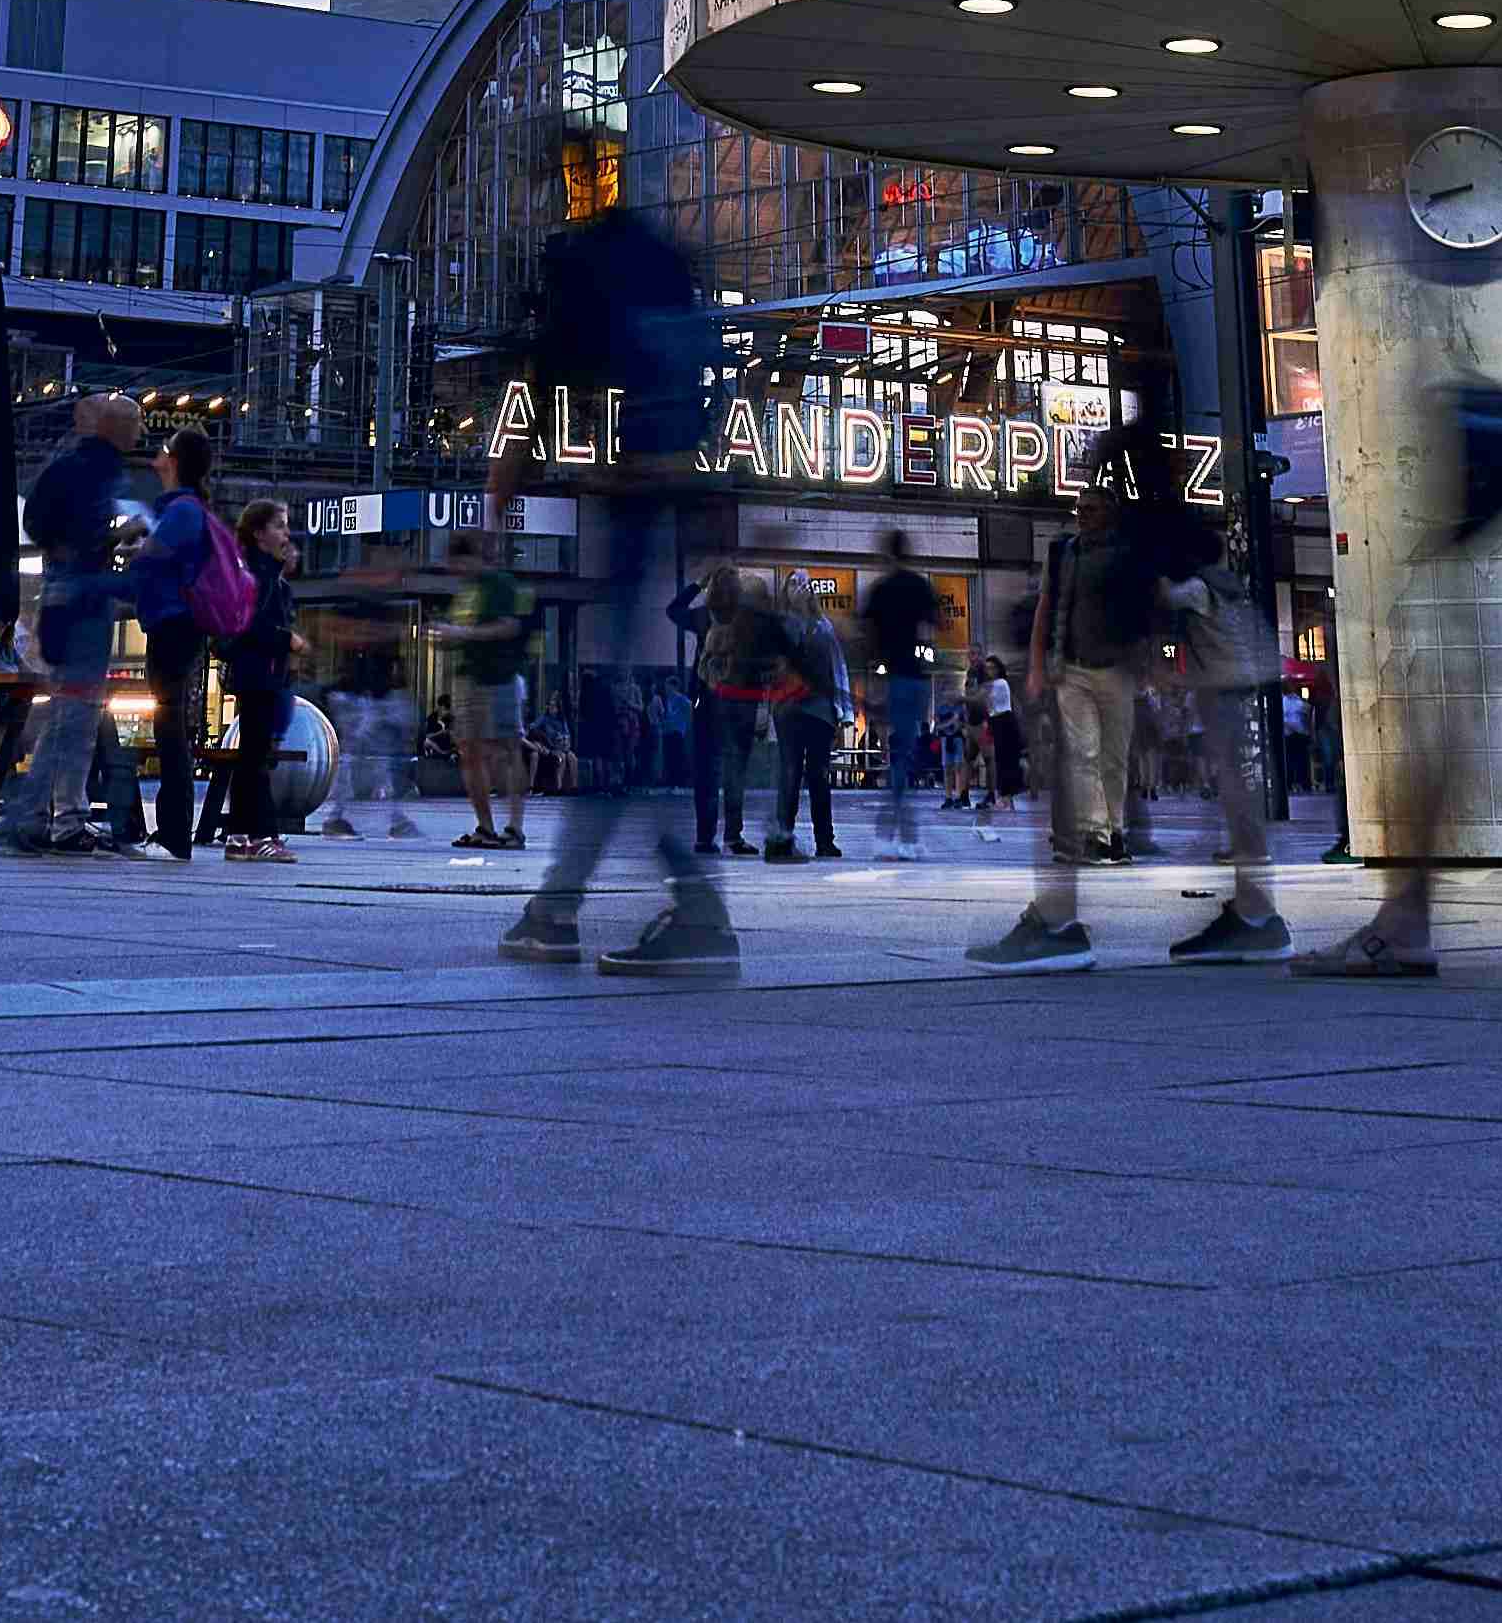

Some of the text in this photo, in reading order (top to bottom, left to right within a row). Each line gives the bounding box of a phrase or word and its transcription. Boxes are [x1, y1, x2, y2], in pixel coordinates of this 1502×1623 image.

[307, 500, 322, 535] U
[428, 492, 450, 527] U
[344, 517, 357, 530] U5
[506, 517, 524, 530] U5
